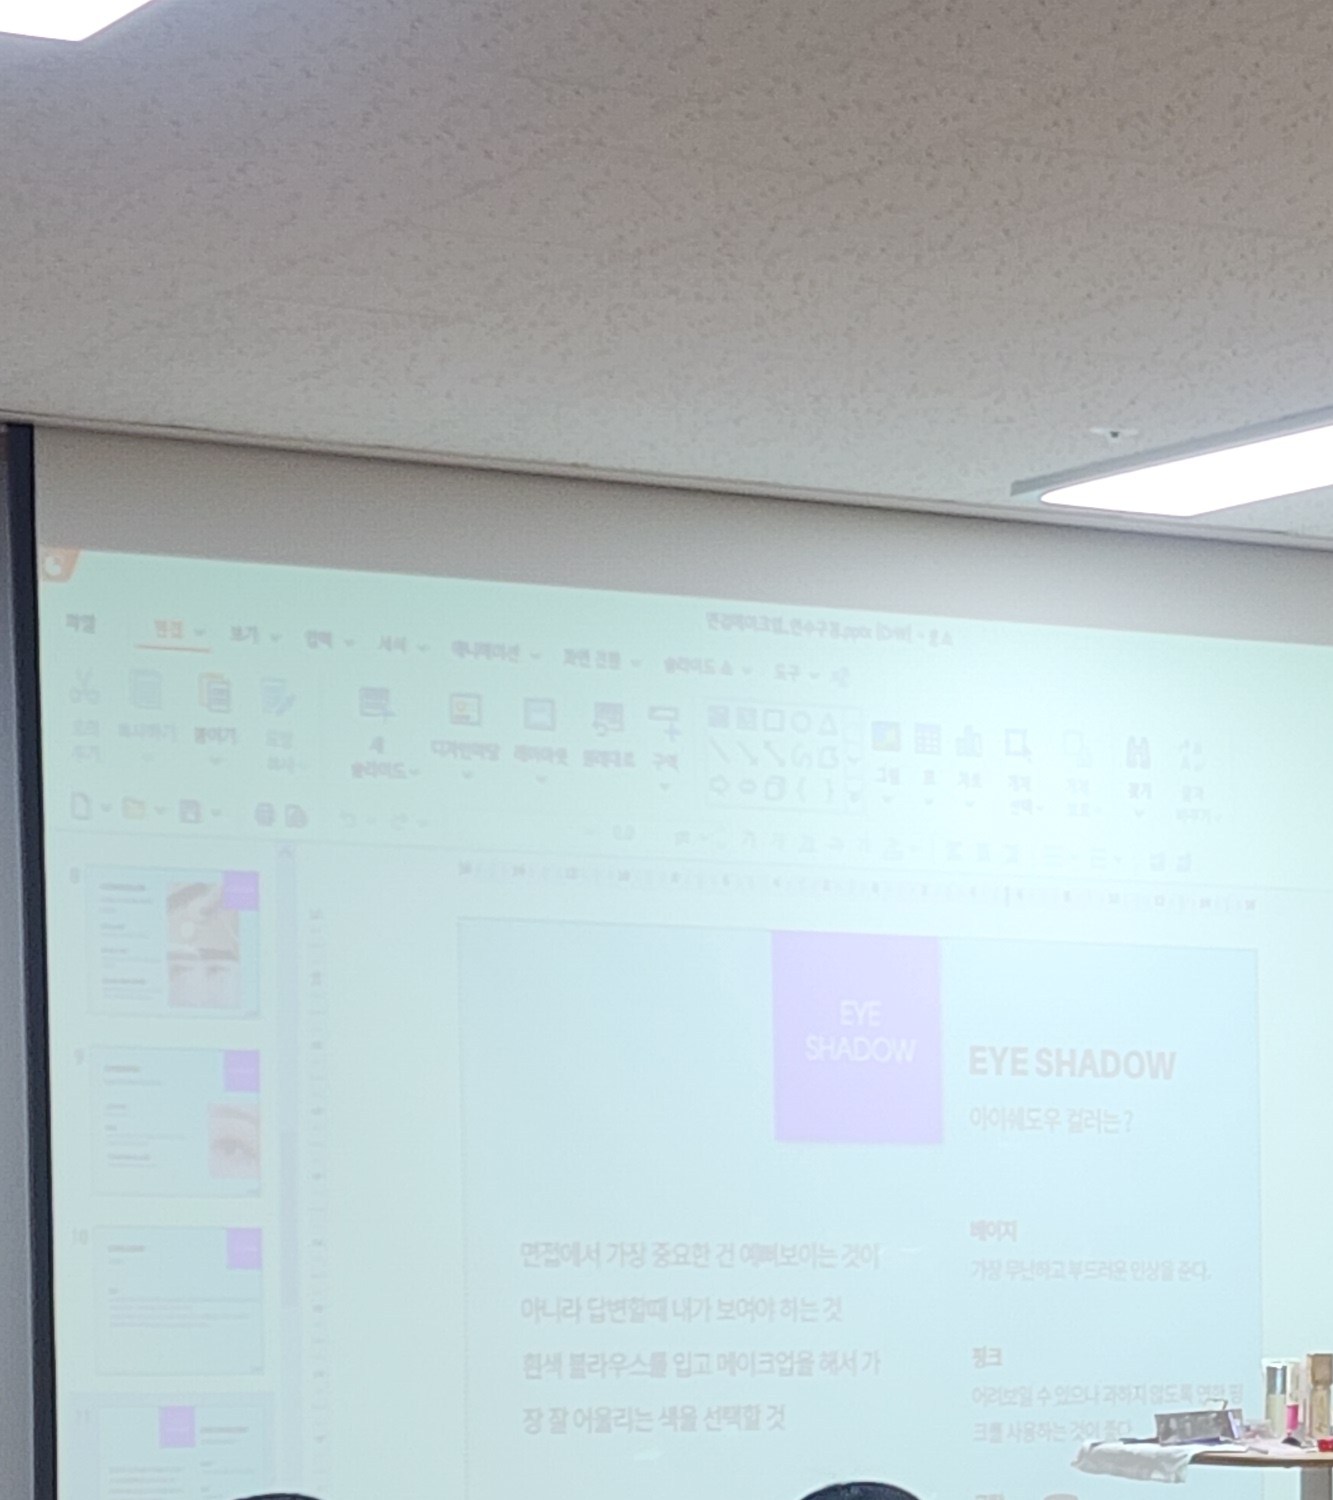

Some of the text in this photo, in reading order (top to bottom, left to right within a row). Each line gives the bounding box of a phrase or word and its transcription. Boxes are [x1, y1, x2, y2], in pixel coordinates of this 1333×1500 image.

[840, 1000, 882, 1027] EYE
[805, 1035, 917, 1063] SHADOW
[968, 1045, 1177, 1081] EYE SHADOW
[1066, 1109, 1134, 1135] 컬러는?
[970, 1219, 1018, 1242] 베이지
[520, 1241, 601, 1268] 면접에서
[605, 1242, 647, 1268] 가장
[651, 1242, 711, 1268] 중요한
[715, 1243, 736, 1267] 건
[841, 1242, 882, 1269] 것이
[521, 1297, 583, 1324] 아니라
[586, 1297, 668, 1324] 답변할때
[672, 1297, 713, 1324] 내가
[716, 1296, 777, 1323] 보여야
[823, 1296, 844, 1323] 것
[522, 1350, 881, 1380] 흰색 블라우스를 입고 메이크업을 해서 가
[522, 1404, 786, 1435] 장 잘 어울리는 색을 선택할 것
